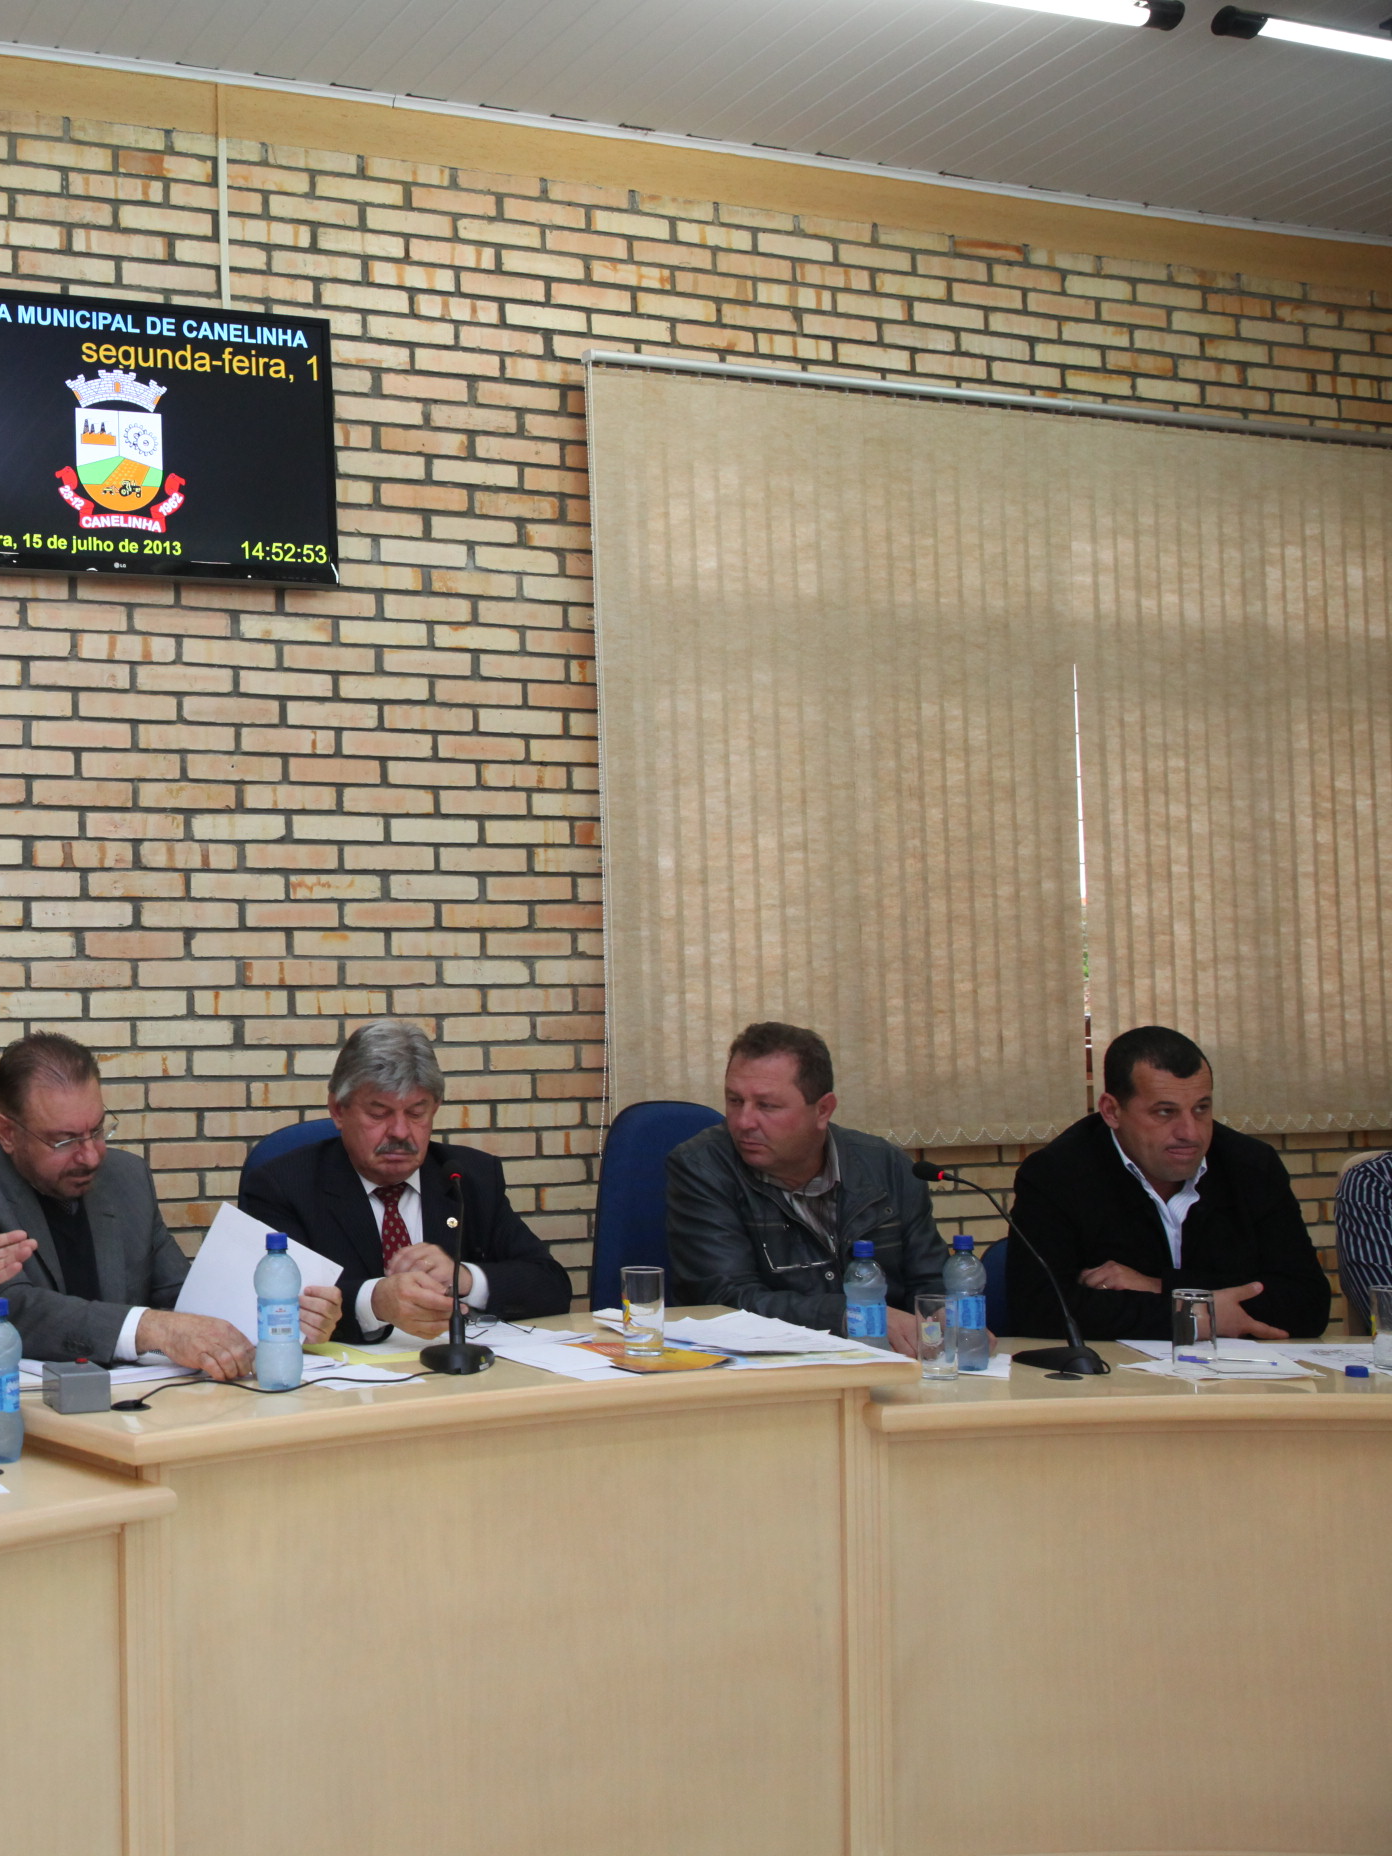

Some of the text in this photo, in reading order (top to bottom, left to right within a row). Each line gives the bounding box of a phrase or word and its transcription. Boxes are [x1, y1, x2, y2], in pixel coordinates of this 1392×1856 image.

[17, 305, 140, 333] MUNICIPAL
[146, 316, 176, 336] DE
[182, 320, 308, 348] CANELINHA
[81, 342, 318, 383] segunda-feira, 1
[158, 492, 184, 516] 1962
[81, 515, 162, 533] CANELINHA
[22, 533, 42, 548] 15
[47, 534, 67, 550] de
[71, 536, 114, 554] julho
[118, 538, 139, 554] de
[143, 540, 182, 556] 2013
[240, 540, 328, 564] 14:52:53
